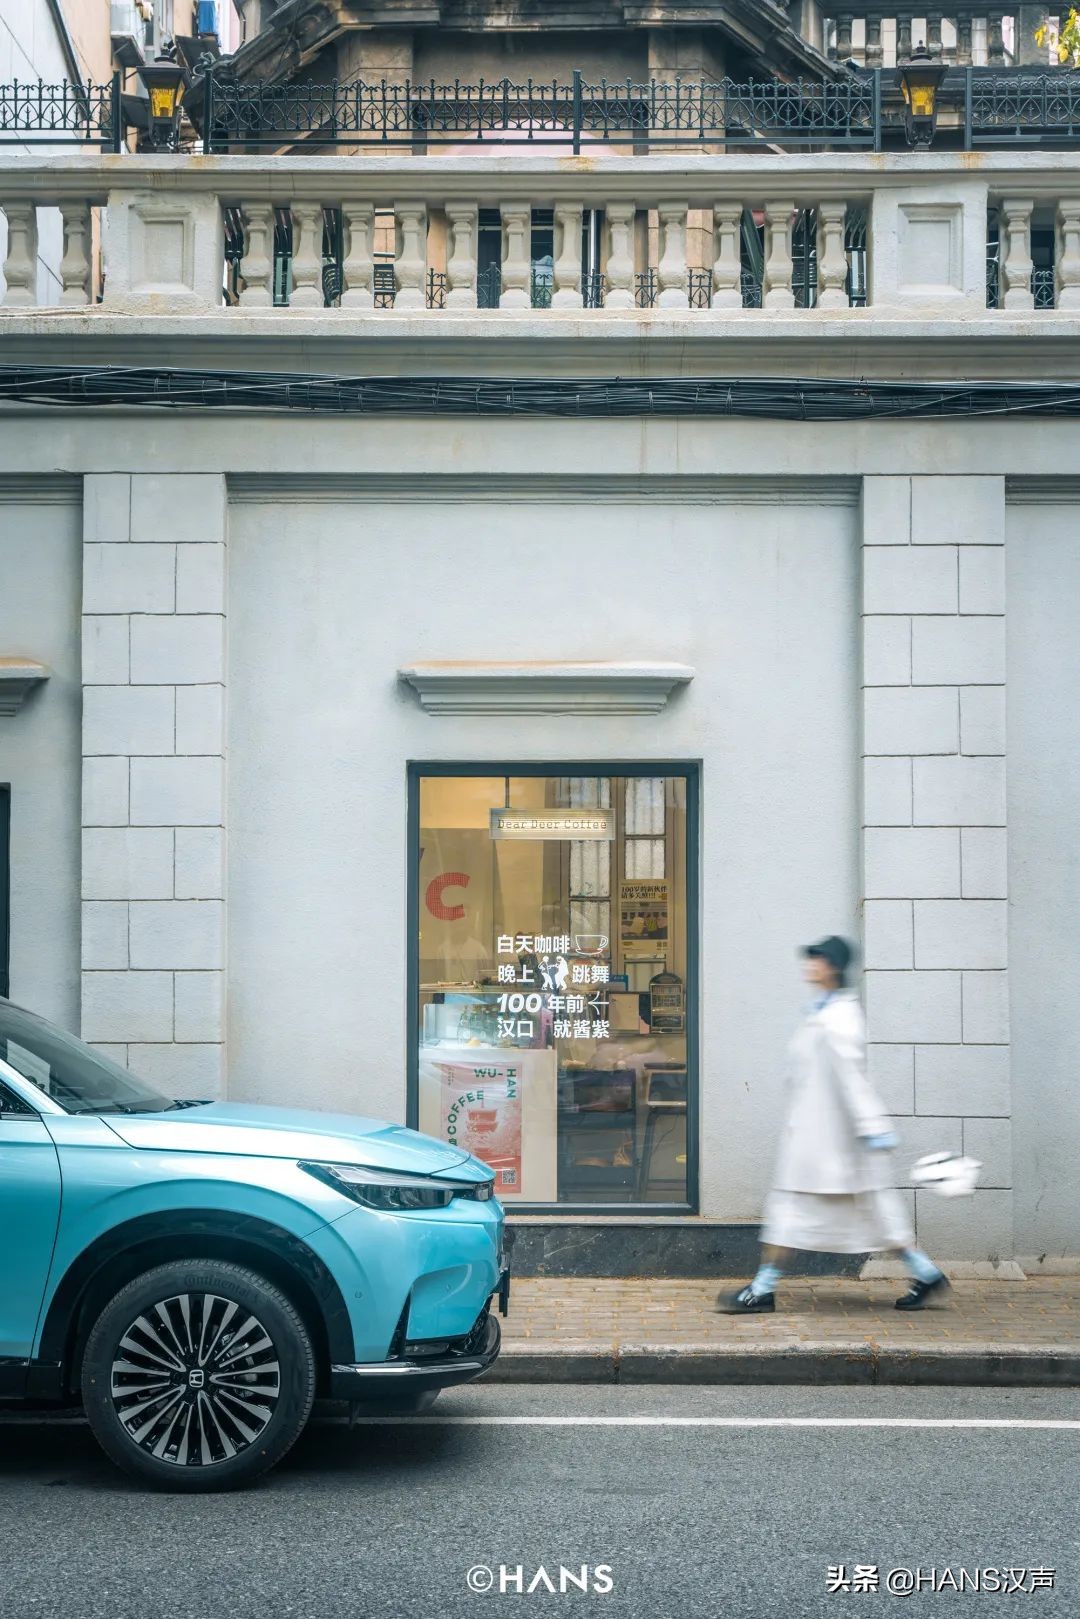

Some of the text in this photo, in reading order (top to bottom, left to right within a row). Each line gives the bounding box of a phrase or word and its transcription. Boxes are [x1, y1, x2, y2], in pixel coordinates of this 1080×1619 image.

[497, 818, 607, 829] Dear Deer Coffee
[497, 934, 571, 954] 白天咖啡
[498, 964, 609, 984] 晚上 跳舞
[497, 993, 585, 1013] 100 年前
[497, 1018, 610, 1038] 汉口 就酱紫
[506, 1068, 517, 1098] HAN
[447, 1090, 485, 1135] COFFEE
